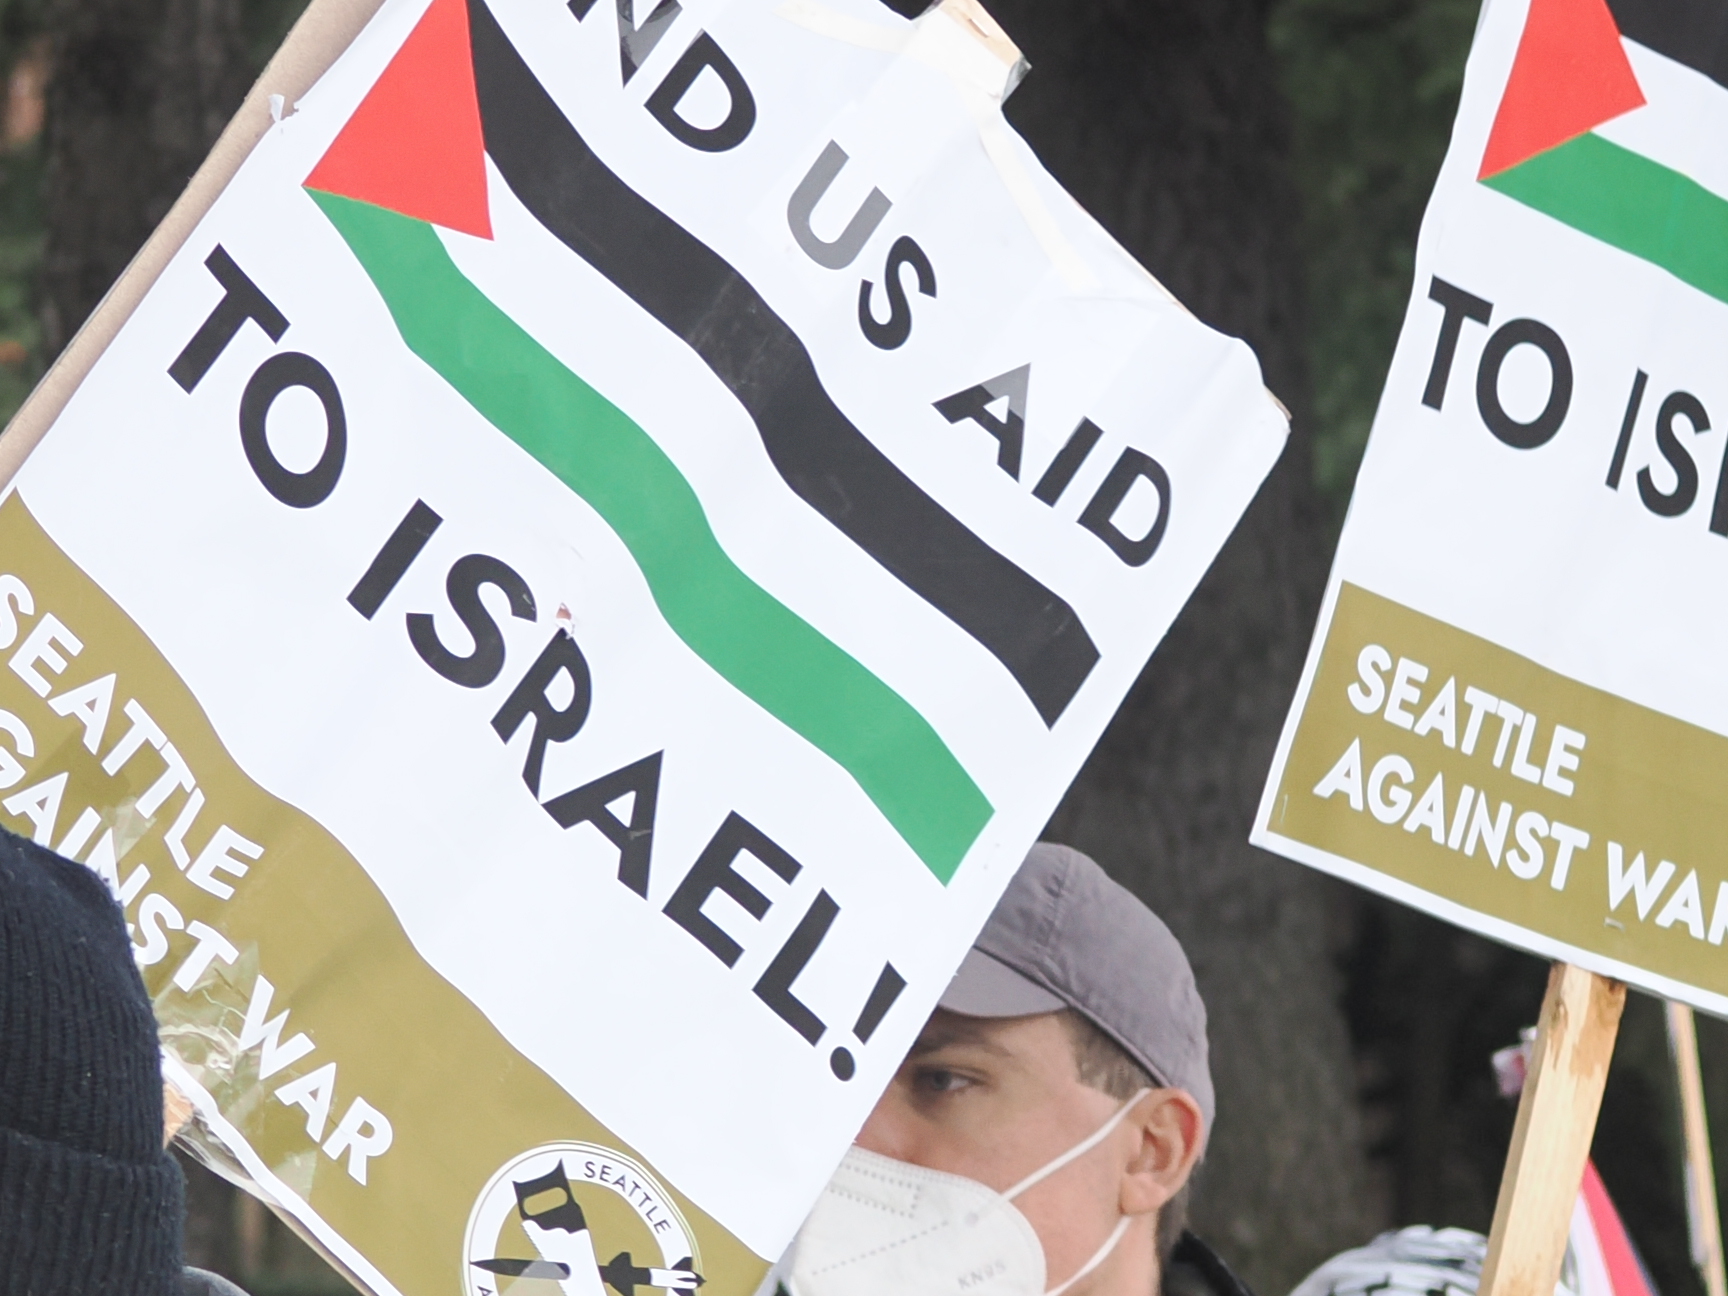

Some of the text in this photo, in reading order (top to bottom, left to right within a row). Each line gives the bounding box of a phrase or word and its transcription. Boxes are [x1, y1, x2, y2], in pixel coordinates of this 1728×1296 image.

[787, 140, 936, 350] US
[932, 361, 1171, 567] AID
[1421, 276, 1574, 450] TO
[167, 244, 907, 1082] TO ISRAEL!
[1346, 643, 1587, 799] SEATTLE
[1312, 738, 1590, 892] AGAINST
[238, 974, 394, 1186] WAR
[583, 1160, 671, 1236] SEATTLE
